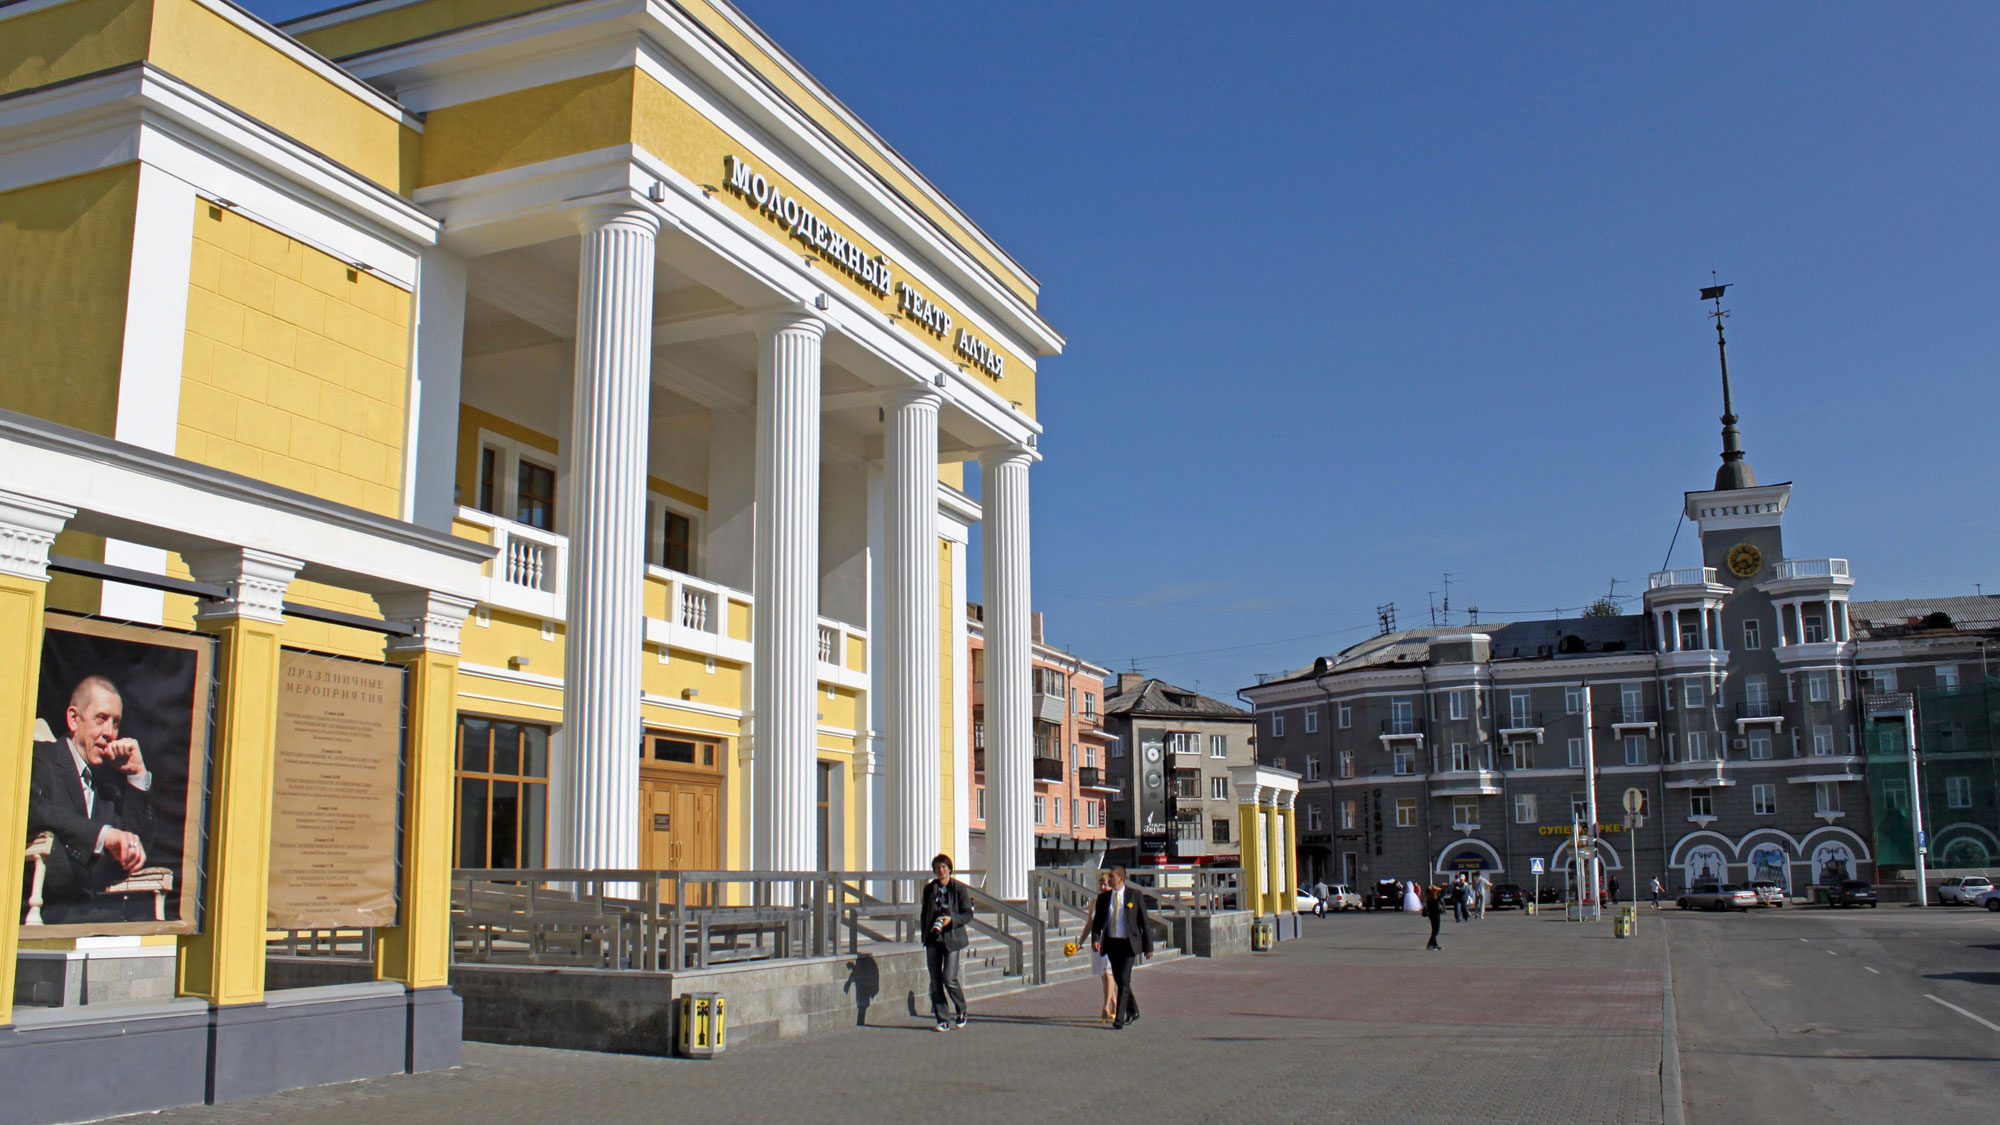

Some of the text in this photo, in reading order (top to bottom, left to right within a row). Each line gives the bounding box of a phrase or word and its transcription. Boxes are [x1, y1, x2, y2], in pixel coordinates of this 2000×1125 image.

[731, 155, 1004, 379] МОЛОДЕЖНЫЙ ТЕАТР АЛТАЯ
[287, 666, 384, 690] ПРАЗДНИЧНЫЕ
[284, 682, 383, 704] МЕРОПРИЯТИЯ
[1538, 823, 1626, 835] СУПЕРКЕТ
